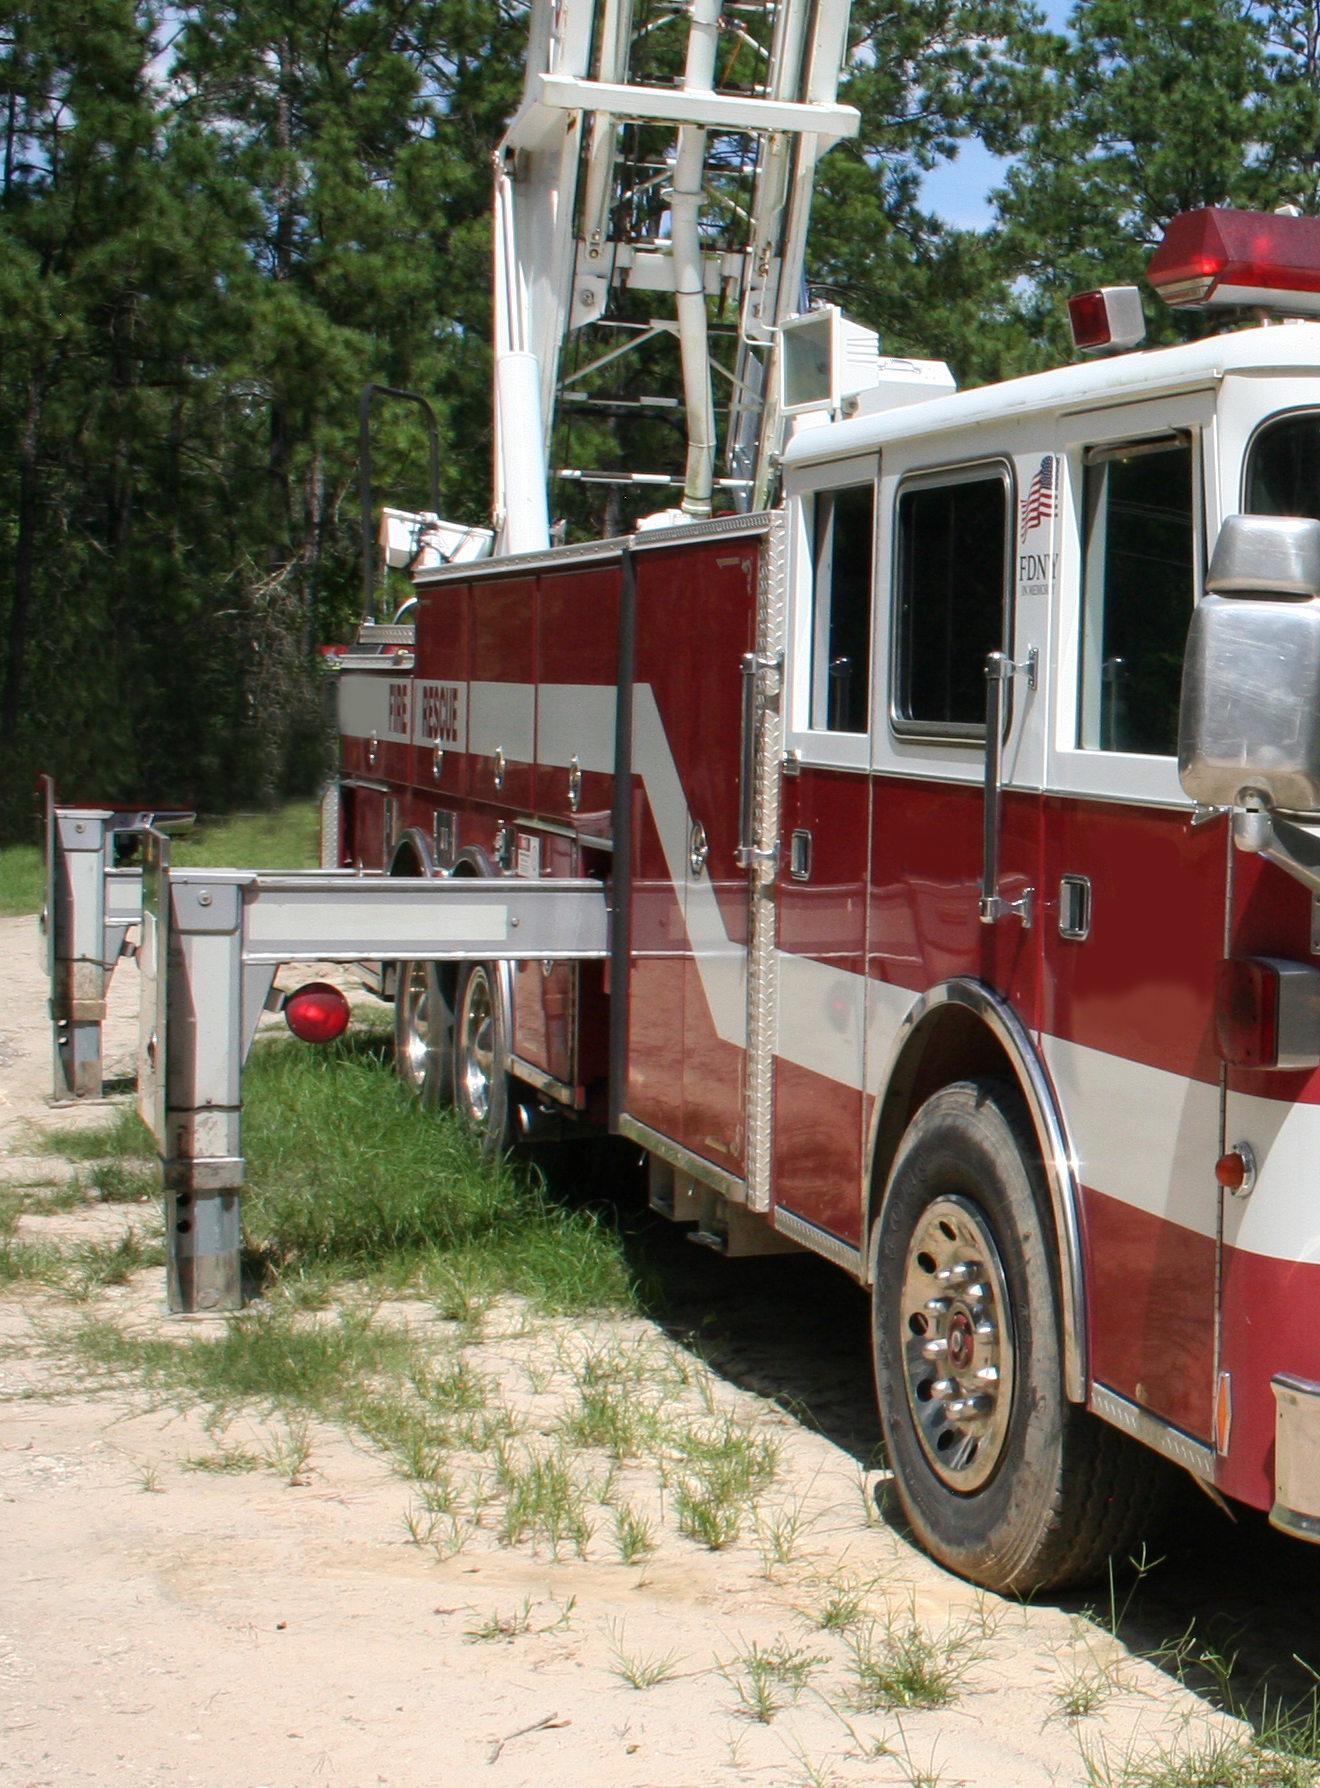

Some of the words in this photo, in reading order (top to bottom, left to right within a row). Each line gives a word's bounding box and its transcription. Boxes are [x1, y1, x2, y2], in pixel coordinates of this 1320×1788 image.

[1019, 553, 1059, 581] FDNY
[388, 684, 408, 735] FIRE
[422, 686, 458, 742] RESCUE
